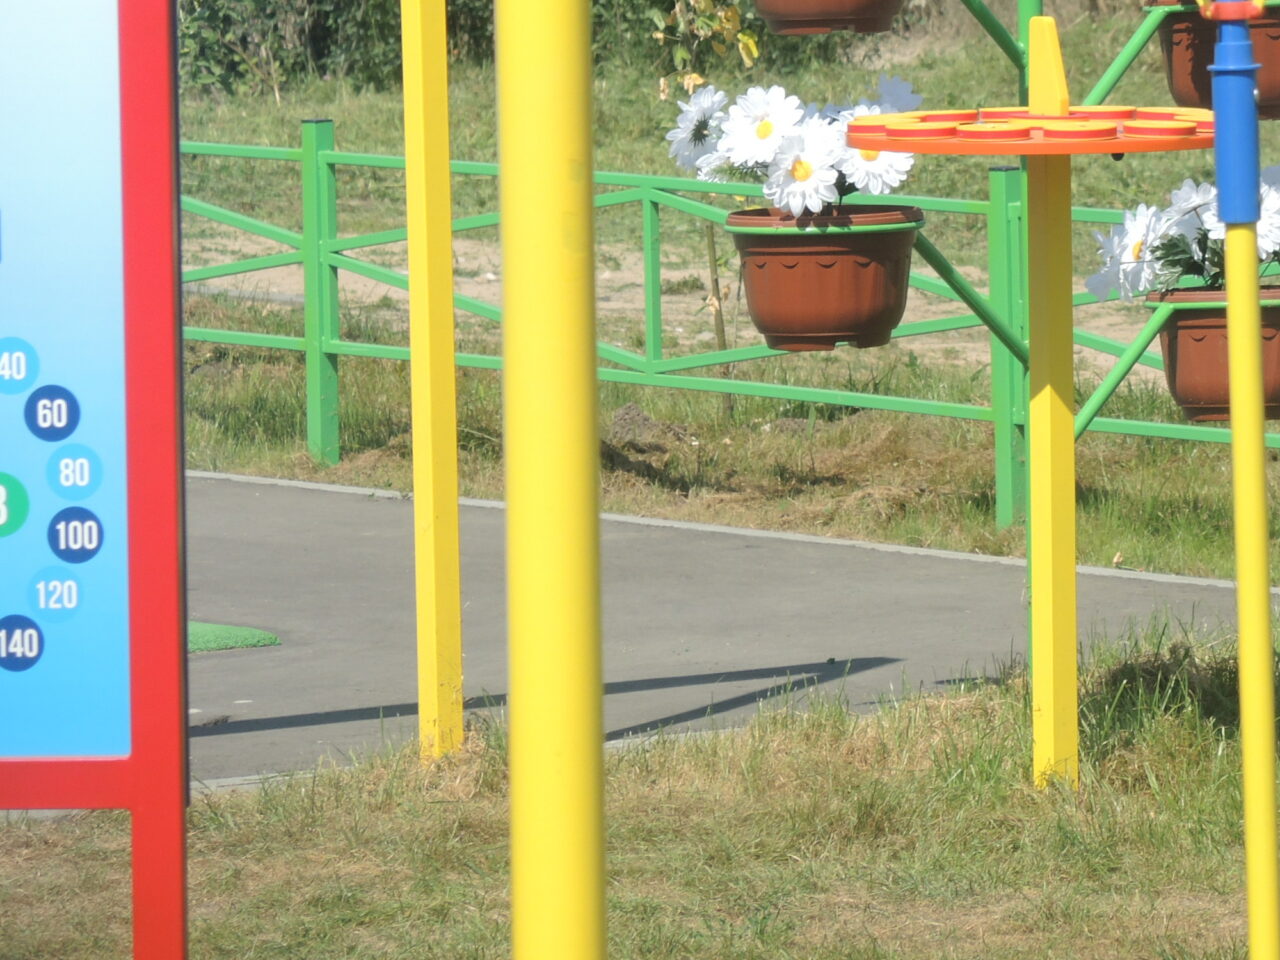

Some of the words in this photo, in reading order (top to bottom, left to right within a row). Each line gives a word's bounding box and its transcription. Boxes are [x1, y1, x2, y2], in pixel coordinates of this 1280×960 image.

[0, 351, 27, 380] 40
[36, 398, 69, 429] 60
[59, 457, 90, 487] 80
[55, 520, 99, 551] 100
[36, 580, 78, 609] 120
[0, 628, 39, 658] 140
